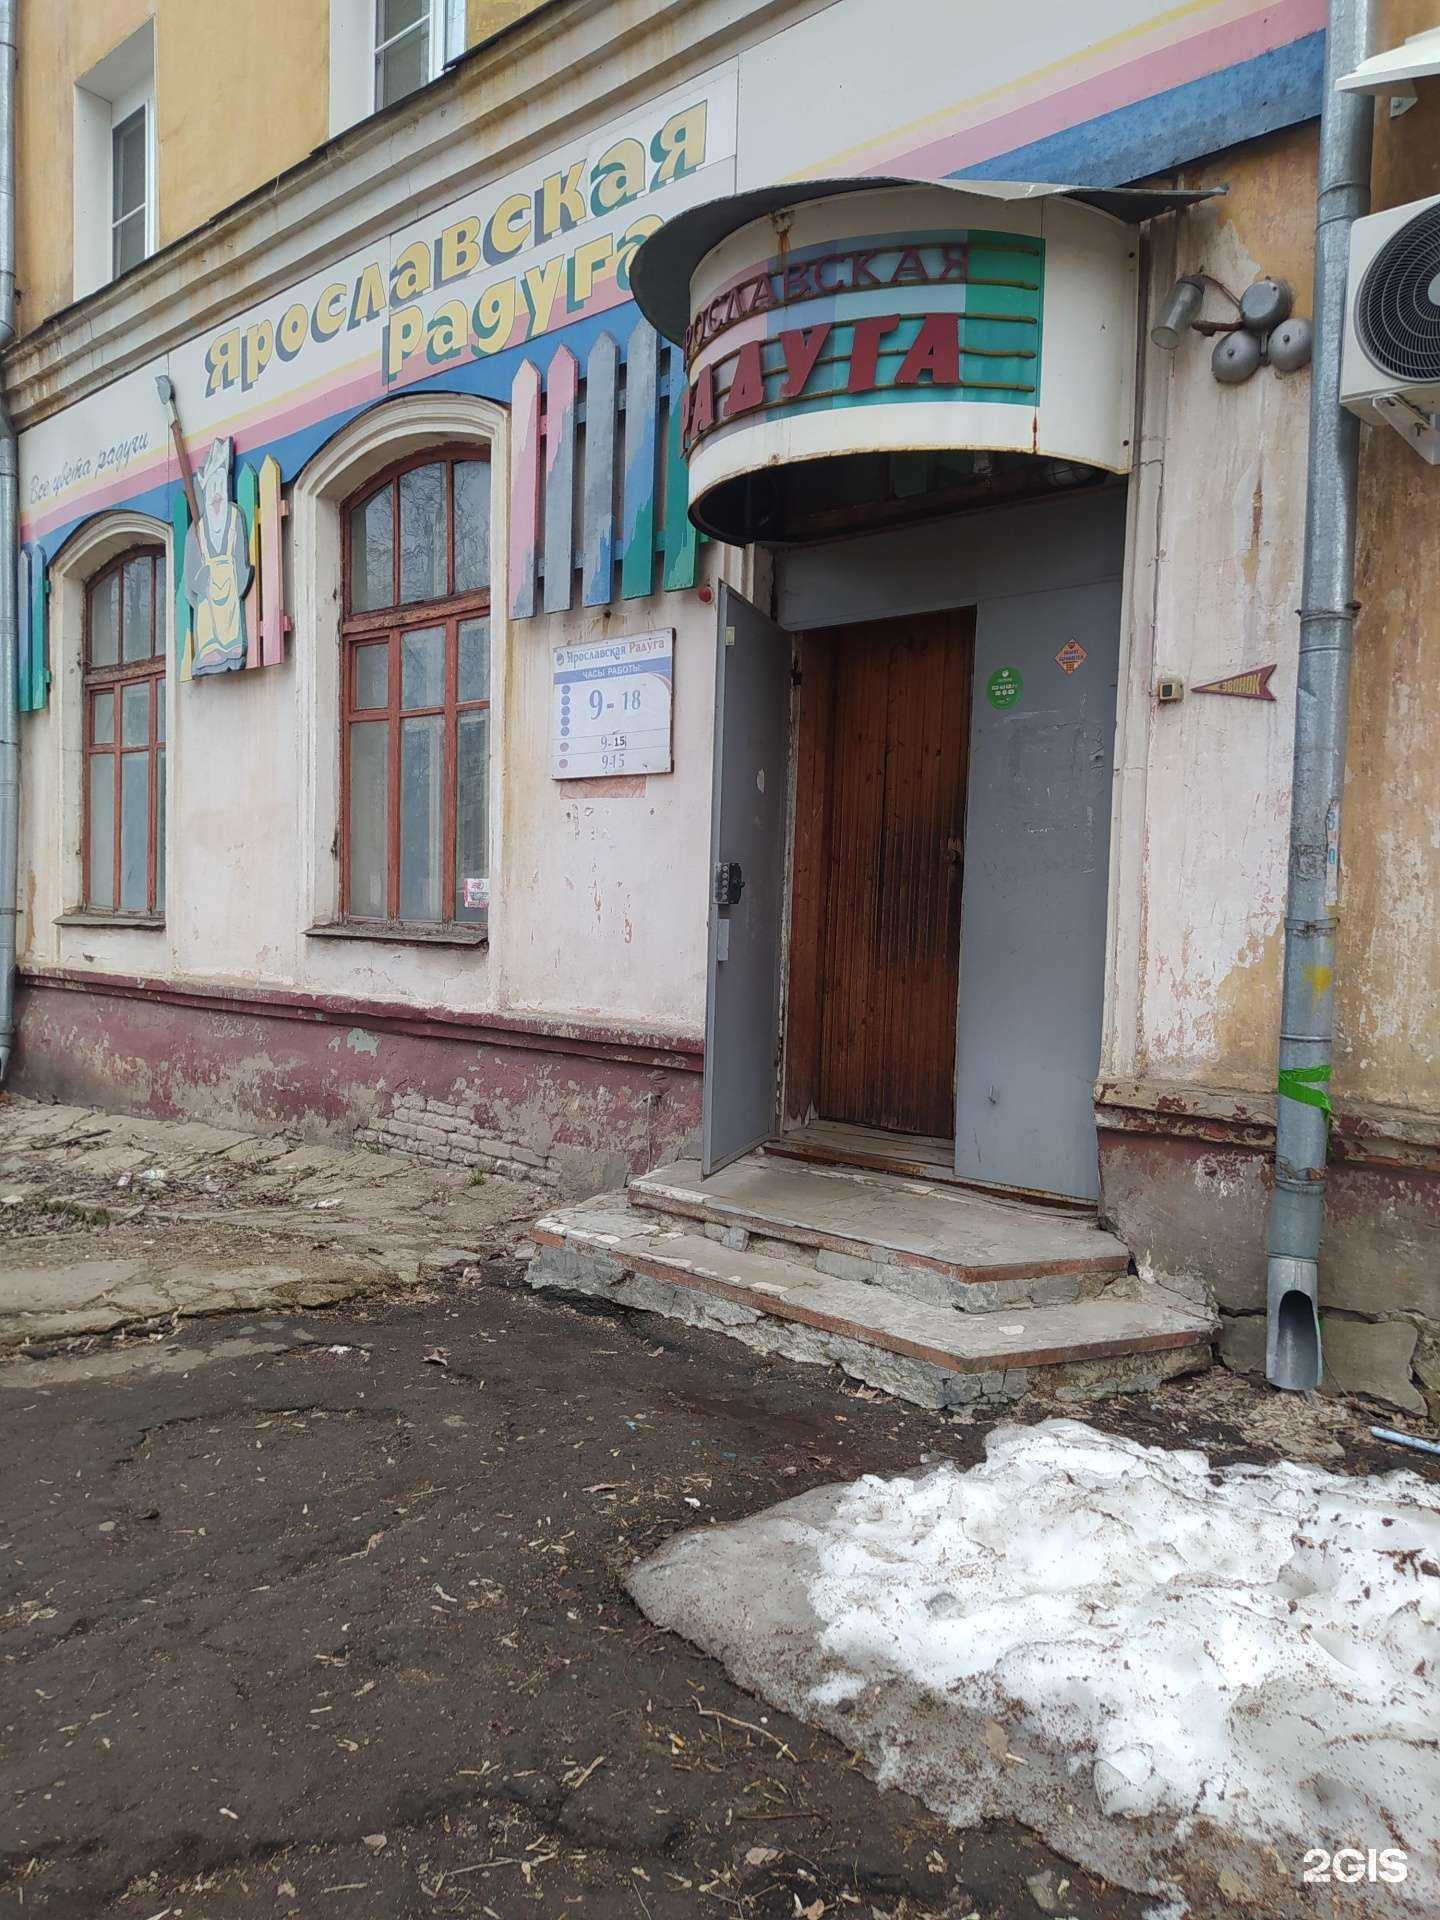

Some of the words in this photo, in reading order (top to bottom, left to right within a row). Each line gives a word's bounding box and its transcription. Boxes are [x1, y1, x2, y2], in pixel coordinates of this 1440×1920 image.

[94, 432, 150, 480] радуги
[566, 644, 626, 669] Ярославская
[628, 638, 665, 655] Радуга
[582, 667, 606, 680] ЧАСЫ
